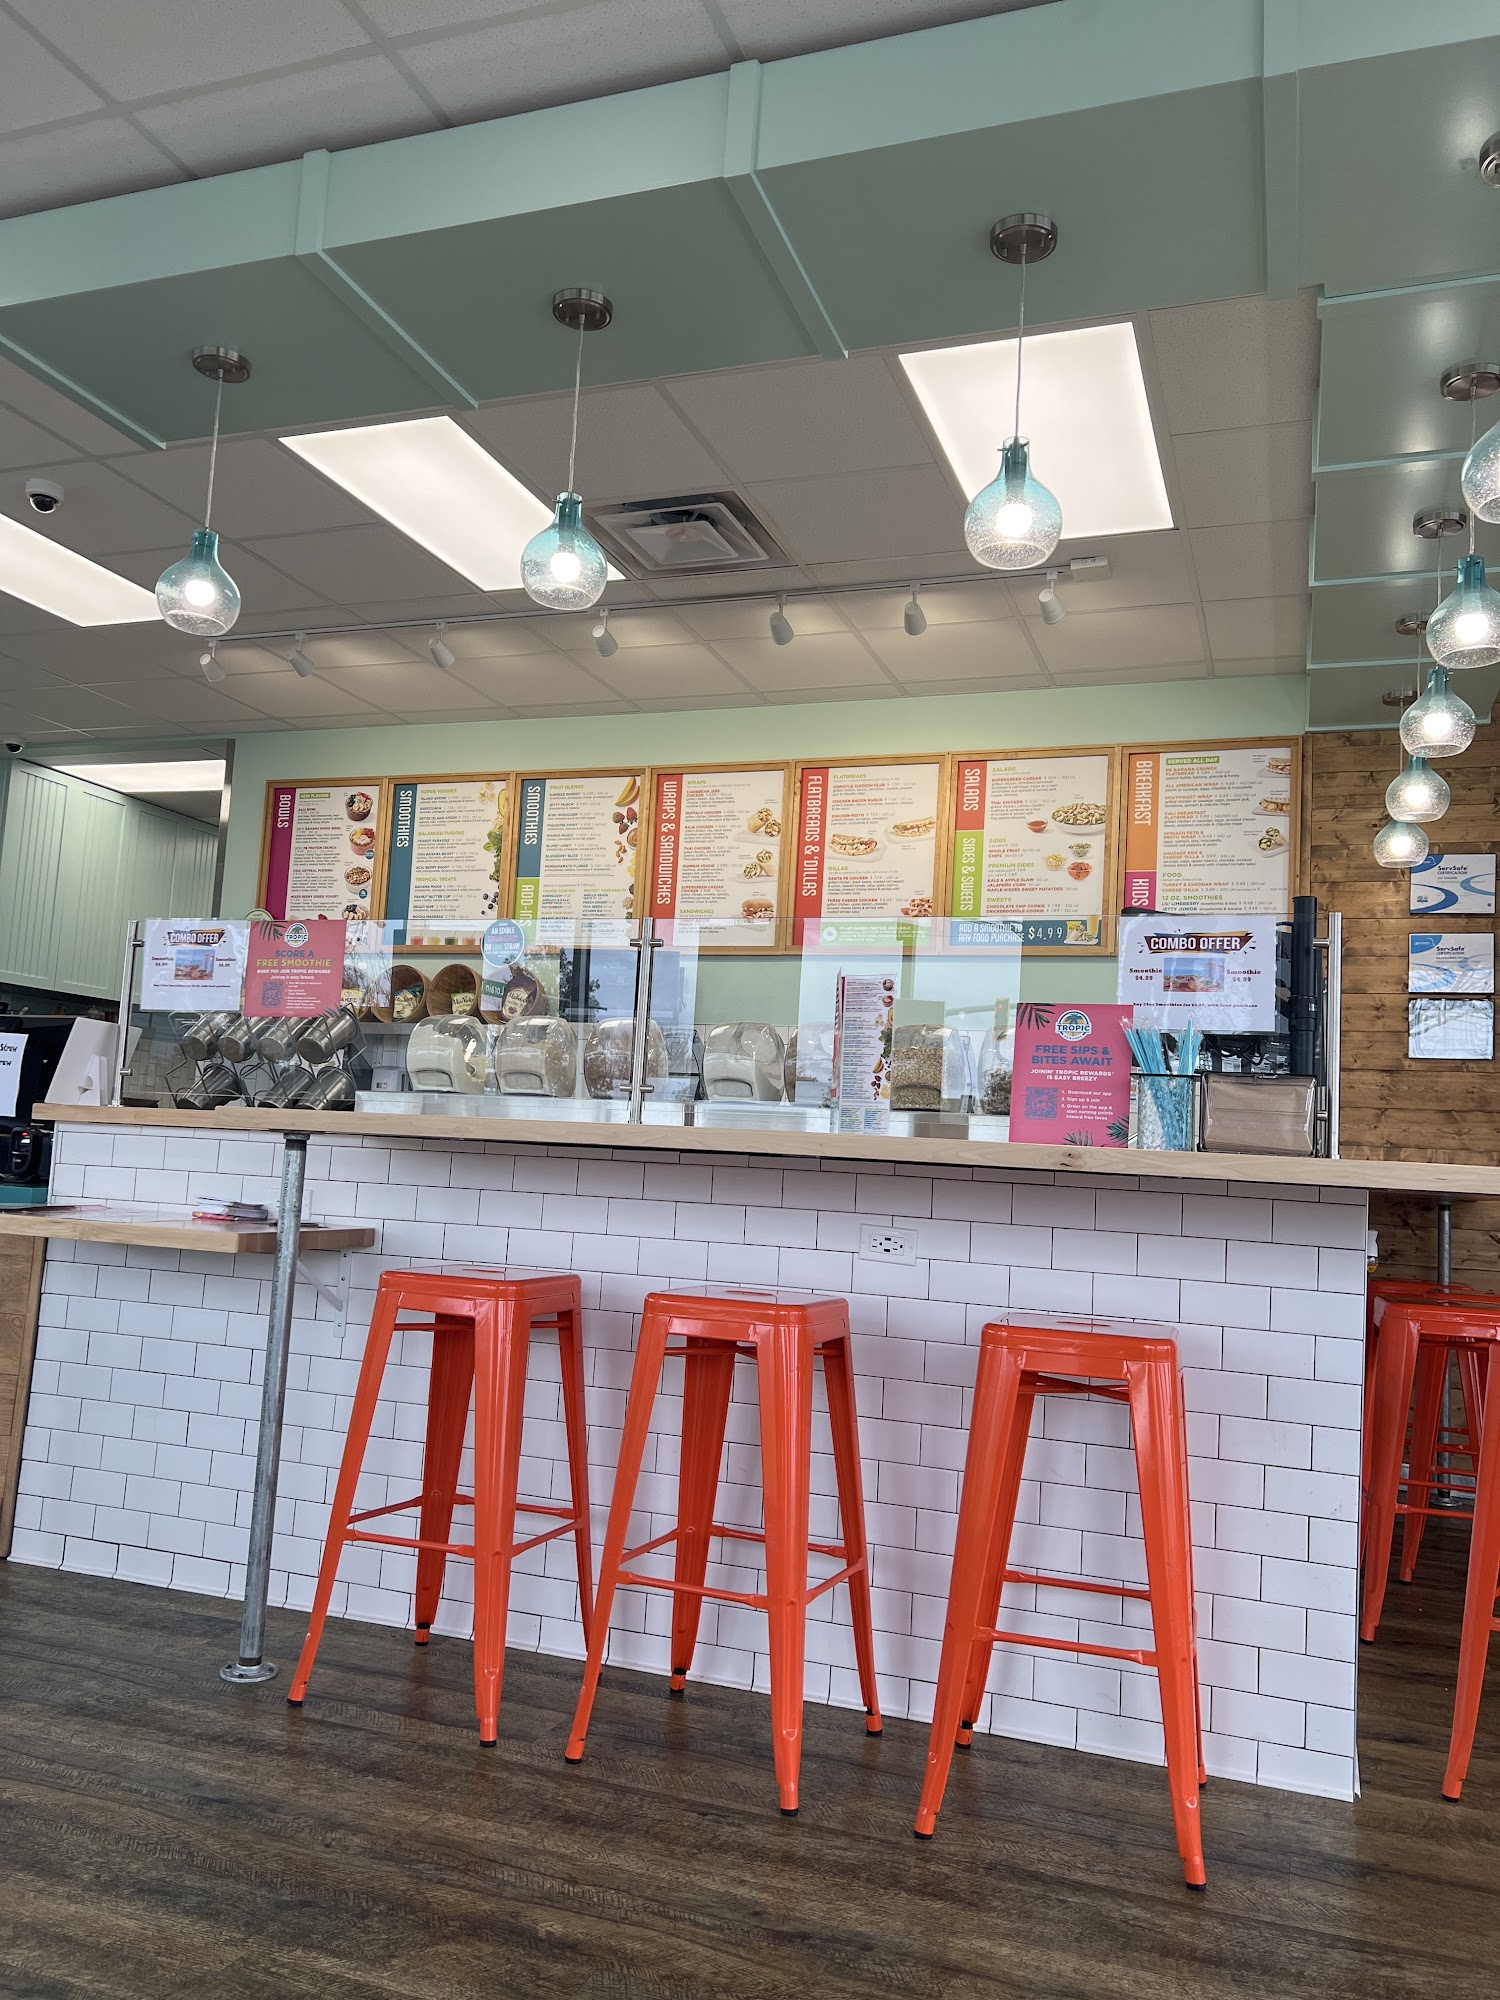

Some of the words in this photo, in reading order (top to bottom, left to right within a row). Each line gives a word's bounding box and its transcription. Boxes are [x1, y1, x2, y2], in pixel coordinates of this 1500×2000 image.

[963, 768, 981, 811] SALADS
[1134, 760, 1153, 826] BREAKFAST
[662, 781, 677, 820] WRAPS
[277, 794, 292, 828] BOWLS
[524, 785, 541, 845] SMOOTHIES
[805, 775, 823, 842] FLATBREADS
[396, 790, 413, 848] SMOOTHIES
[661, 822, 676, 832] &
[804, 845, 820, 855] &
[962, 837, 976, 864] SIDES
[657, 835, 675, 905] SANDWICHES
[802, 856, 819, 897] 'DILLAS
[961, 866, 975, 875] &
[960, 876, 975, 911] SWEETS
[1131, 878, 1150, 906] KIDS
[520, 884, 535, 927] ADD-INS
[491, 927, 499, 935] AN
[499, 926, 516, 935] EDIBLE
[959, 924, 974, 933] ADD
[974, 924, 980, 933] A
[980, 923, 1013, 933] SMOOTHIE
[1014, 923, 1023, 933] TO
[170, 932, 196, 943] COMBO
[197, 932, 219, 943] OFFER
[958, 933, 972, 942] ANY
[972, 933, 990, 942] FOOD
[990, 934, 1024, 943] PURCHASE
[1150, 937, 1196, 950] COMBO
[1199, 937, 1241, 950] OFFER
[503, 942, 521, 950] STRAW
[275, 949, 305, 958] SCORE
[307, 950, 315, 958] A
[256, 959, 279, 967] FREE
[281, 959, 332, 967] SMOOTHIE
[1056, 1024, 1090, 1032] TROPIC
[1035, 1044, 1067, 1054] FREE
[1070, 1045, 1098, 1055] SIPS
[1101, 1046, 1110, 1056] &
[1031, 1055, 1067, 1065] BITES
[1070, 1056, 1113, 1067] AWAIT
